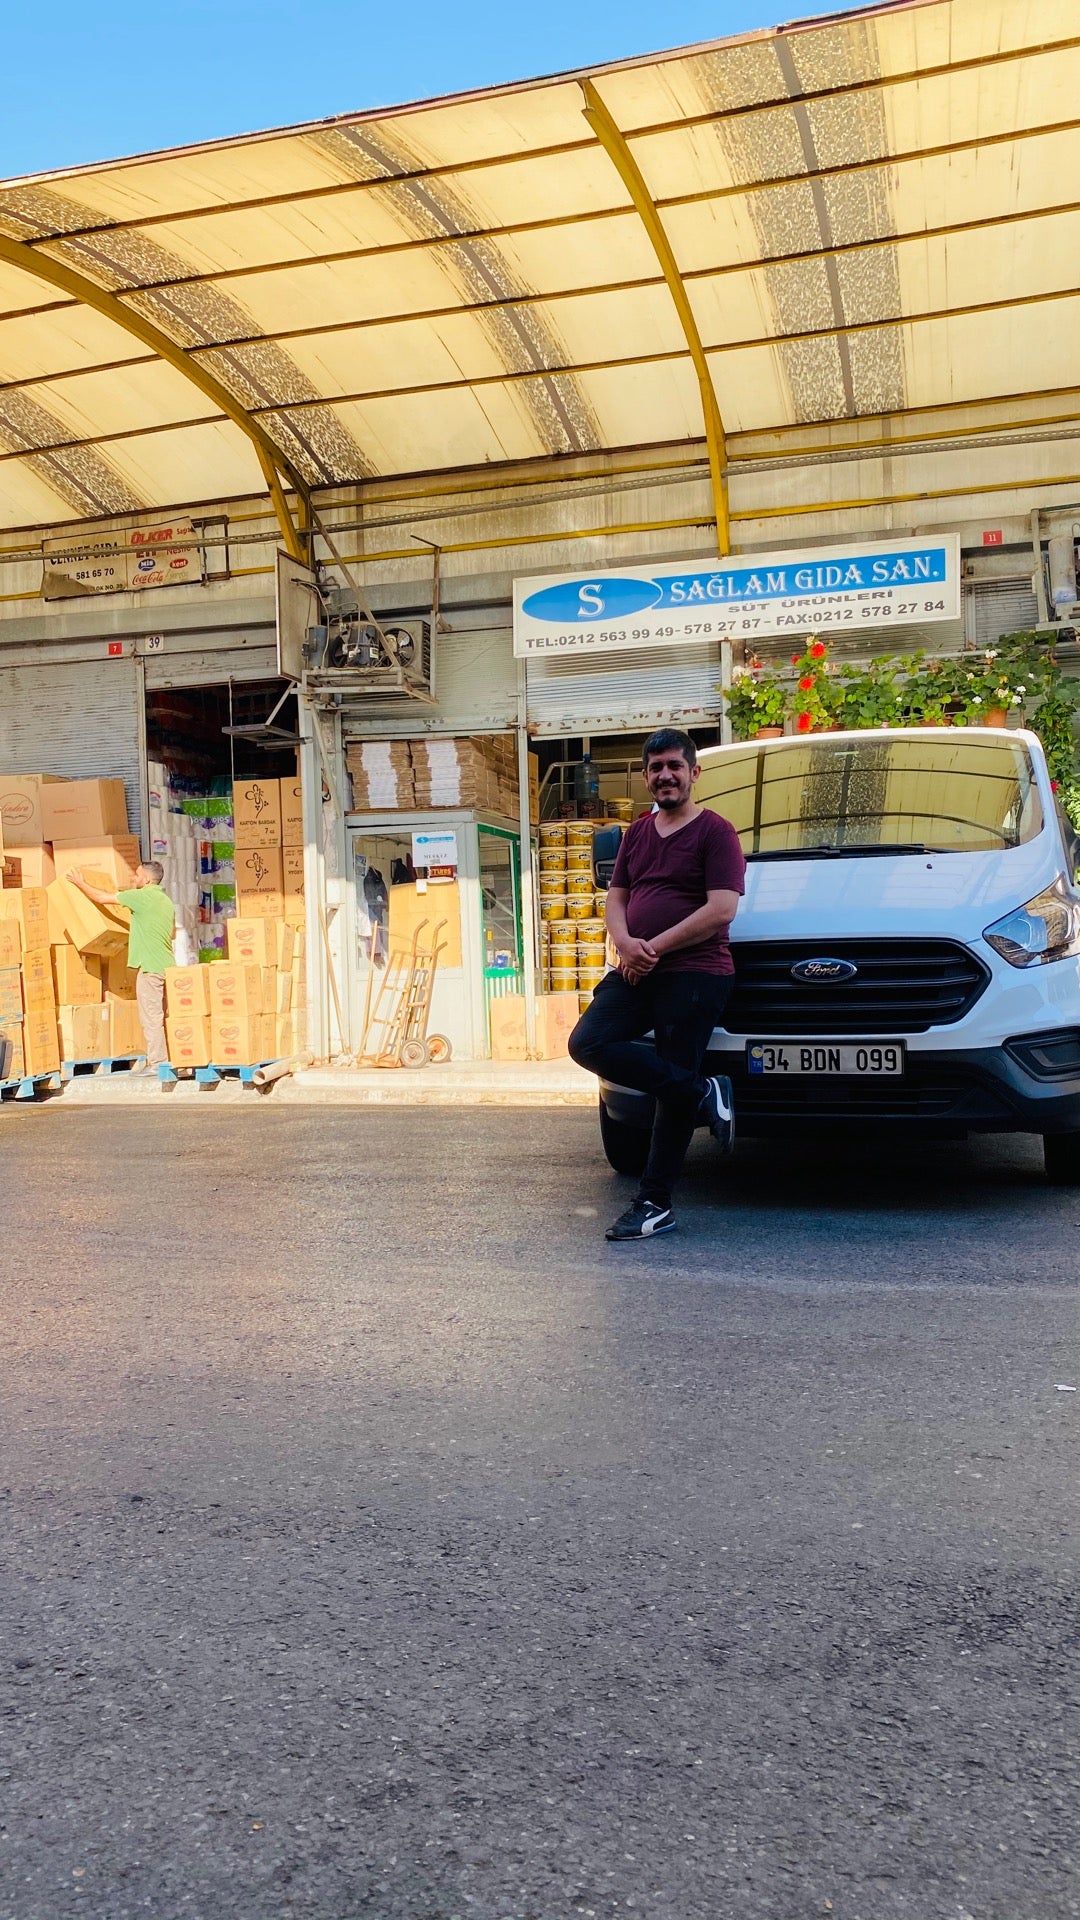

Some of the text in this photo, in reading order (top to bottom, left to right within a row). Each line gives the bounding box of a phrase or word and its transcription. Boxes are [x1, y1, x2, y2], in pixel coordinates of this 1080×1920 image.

[988, 534, 997, 542] 11
[76, 569, 90, 580] 581
[92, 569, 102, 578] 65
[104, 567, 115, 576] 70
[670, 556, 940, 602] SAĞLAM GIDA SAN.
[577, 584, 605, 617] S
[728, 589, 893, 613] SÜT ÜRÜNLERİ
[599, 630, 627, 643] 563
[631, 628, 650, 639] 99
[717, 621, 736, 632] 27
[861, 605, 892, 618] 578
[897, 602, 918, 614] 27
[924, 600, 945, 612] 84
[149, 636, 160, 648] 39
[804, 961, 841, 976] Ford
[763, 1048, 789, 1071] 34
[801, 1048, 841, 1071] BDN
[856, 1048, 897, 1071] 099
